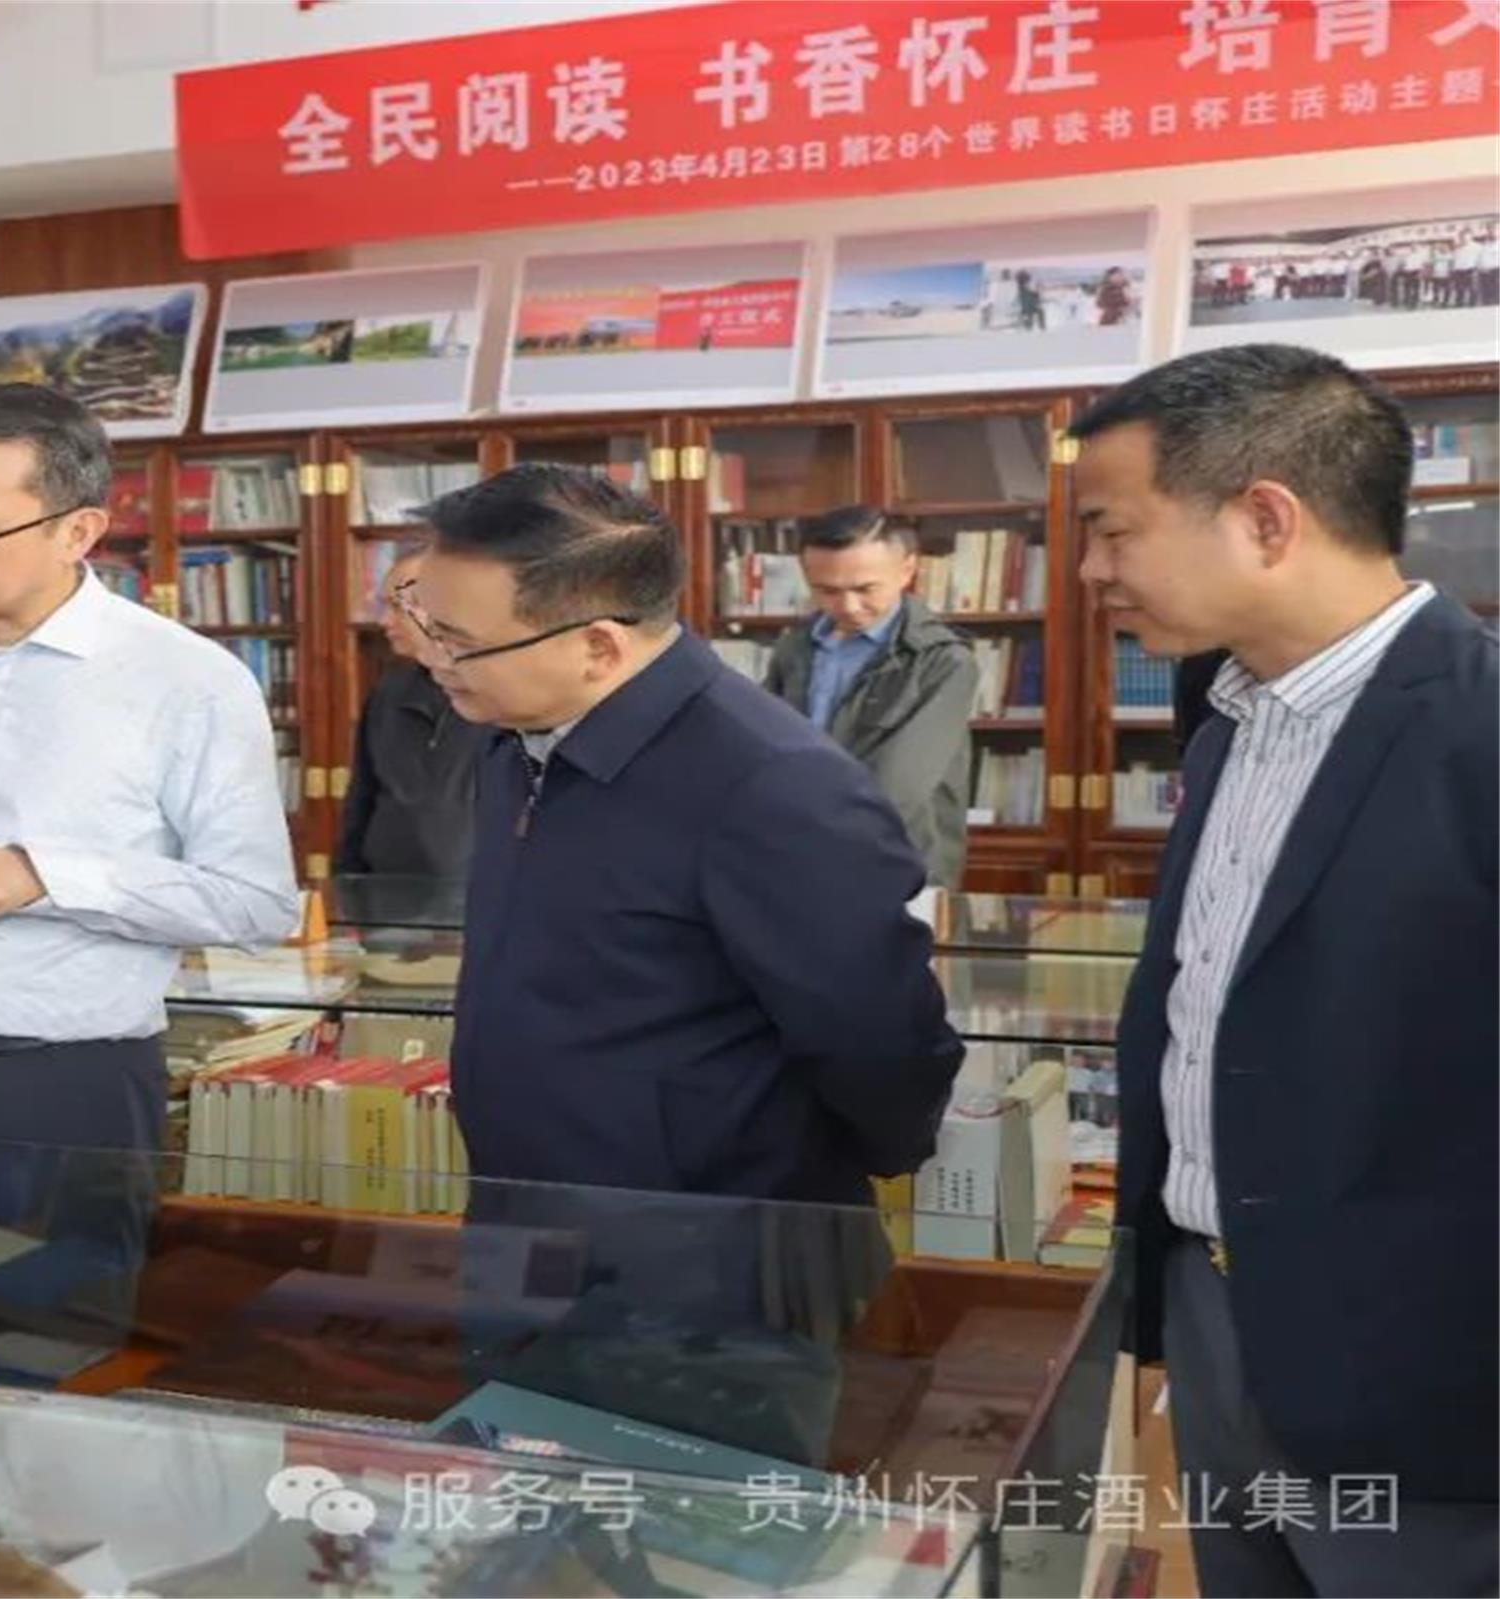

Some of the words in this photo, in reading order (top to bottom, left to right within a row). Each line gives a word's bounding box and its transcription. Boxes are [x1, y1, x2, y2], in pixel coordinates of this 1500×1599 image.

[277, 56, 629, 174] 全民阅读
[693, 0, 1100, 128] 书香怀庄
